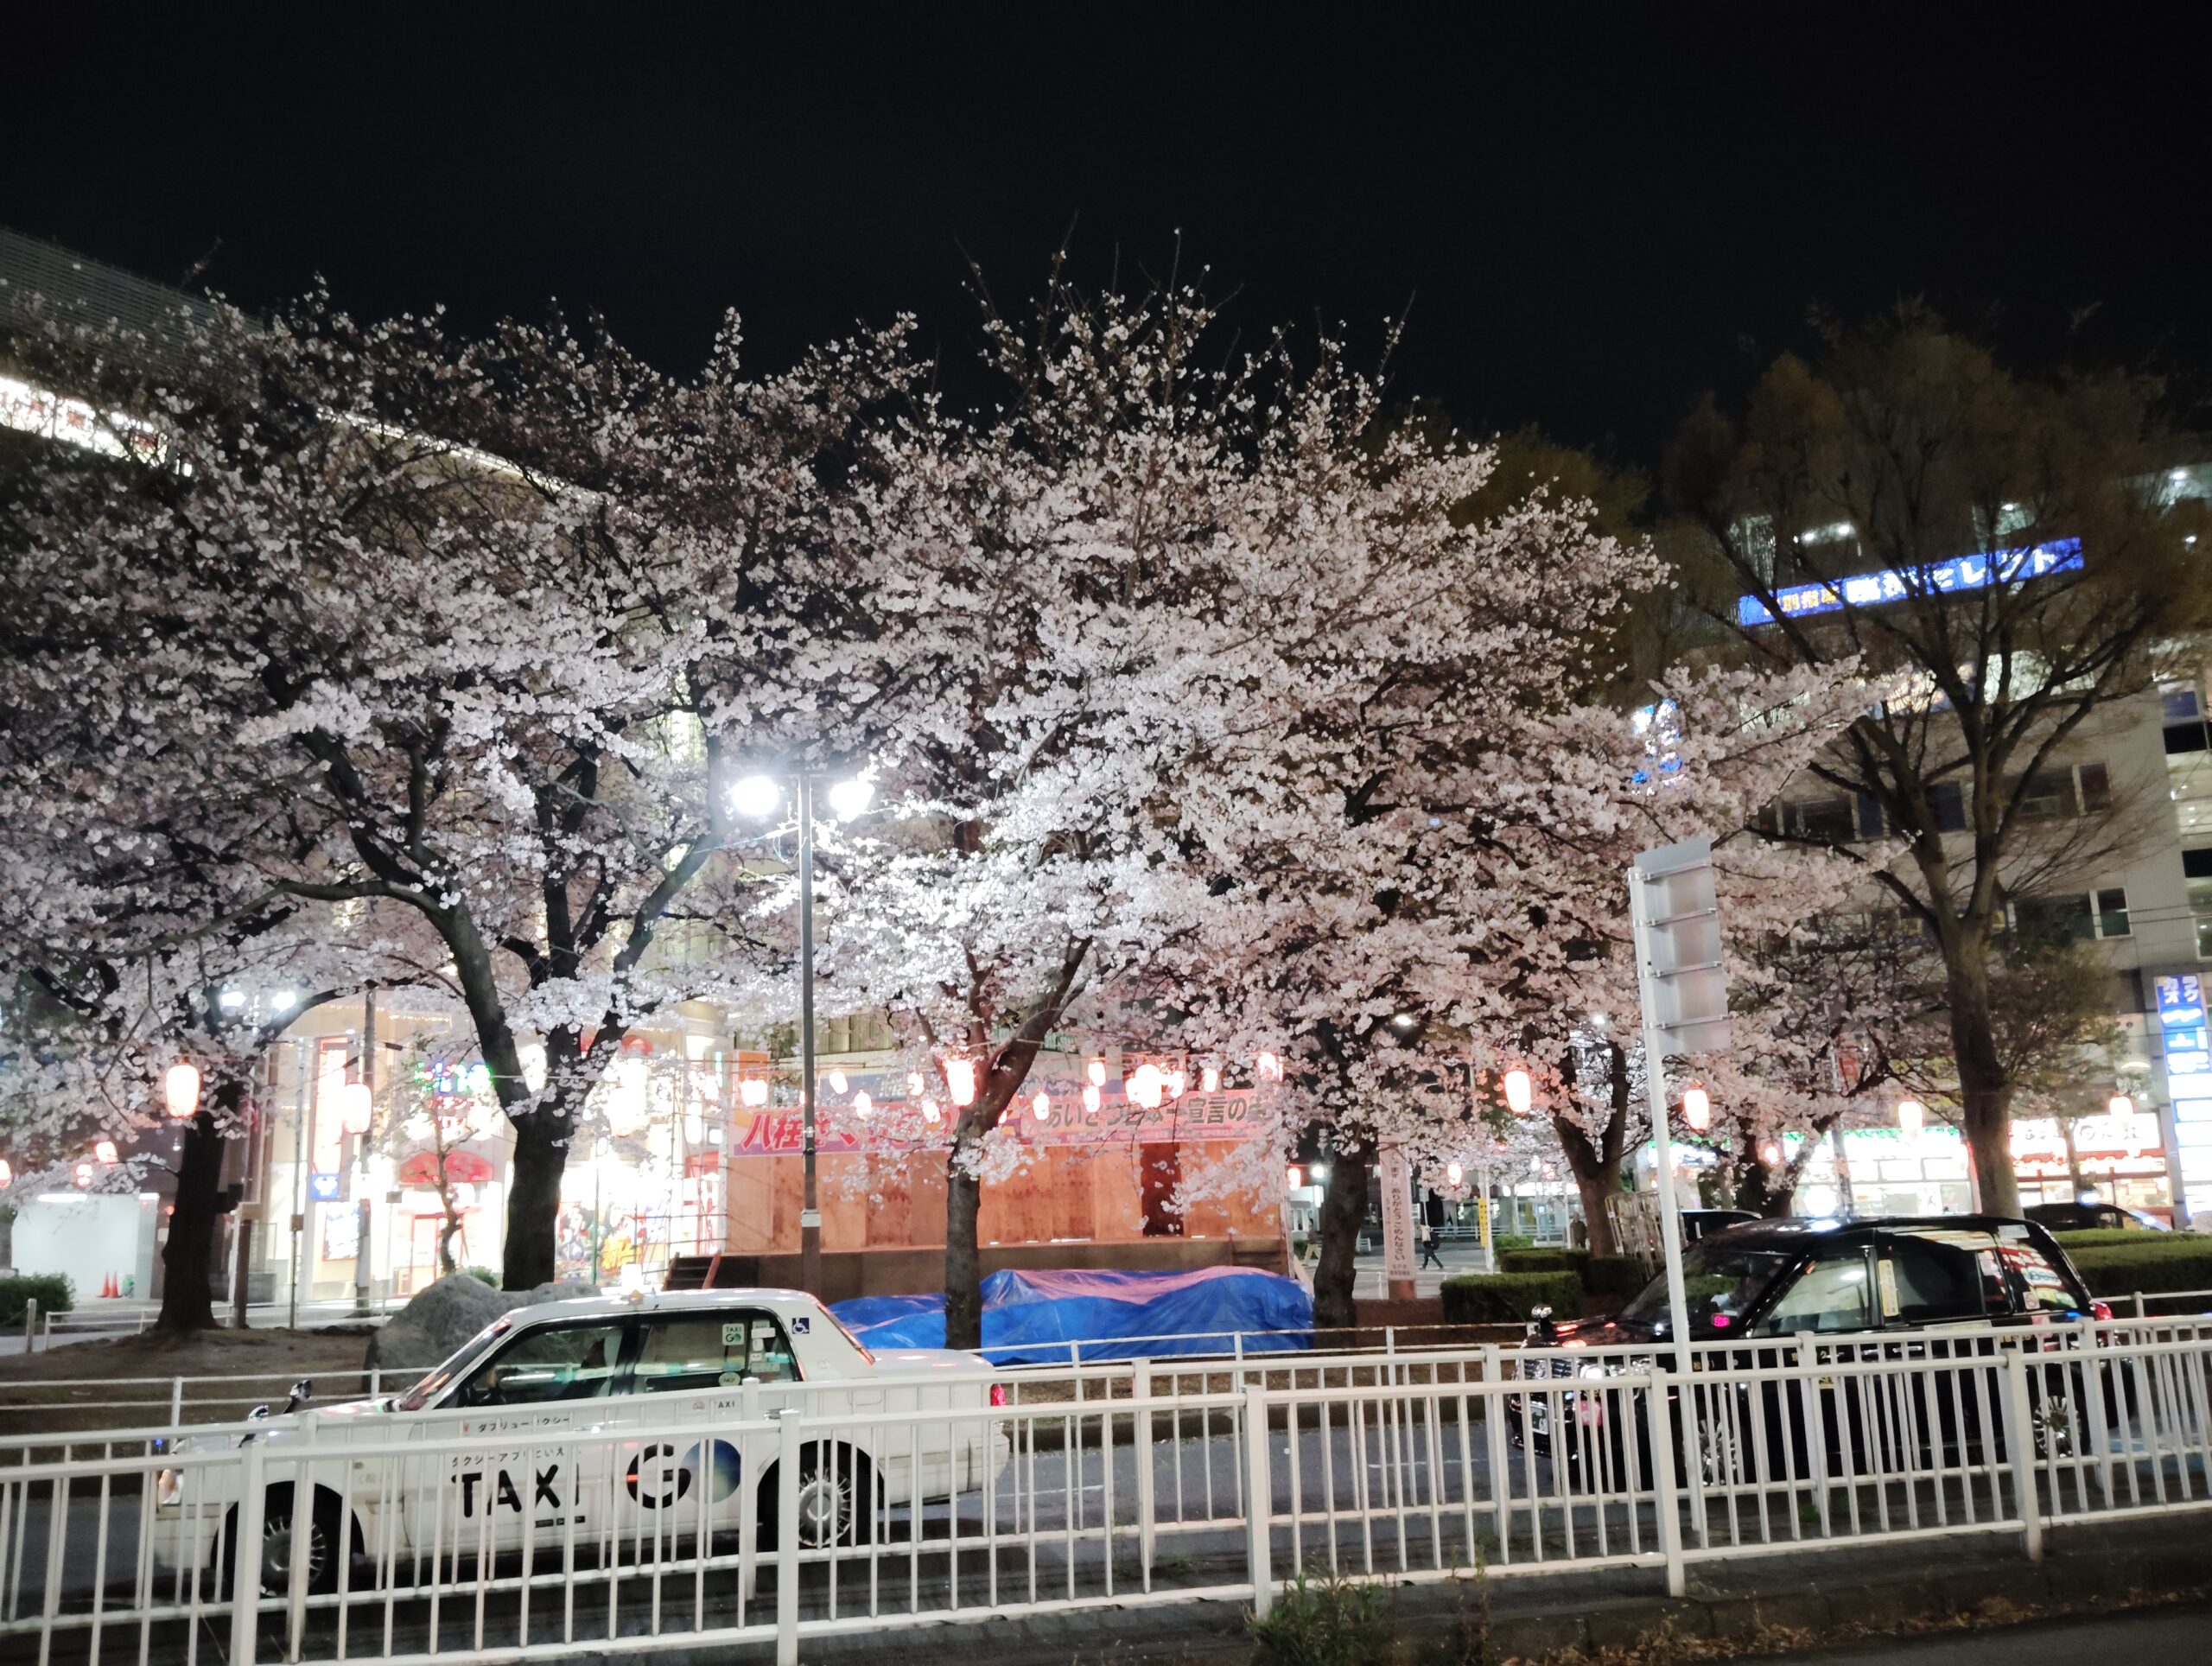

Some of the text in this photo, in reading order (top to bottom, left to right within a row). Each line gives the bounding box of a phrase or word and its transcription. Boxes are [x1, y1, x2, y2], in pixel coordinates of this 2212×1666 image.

[1046, 1095, 1270, 1128] あいさつ一宣言の
[478, 1416, 570, 1433] ダブリュークシー
[451, 1463, 581, 1518] TAXI
